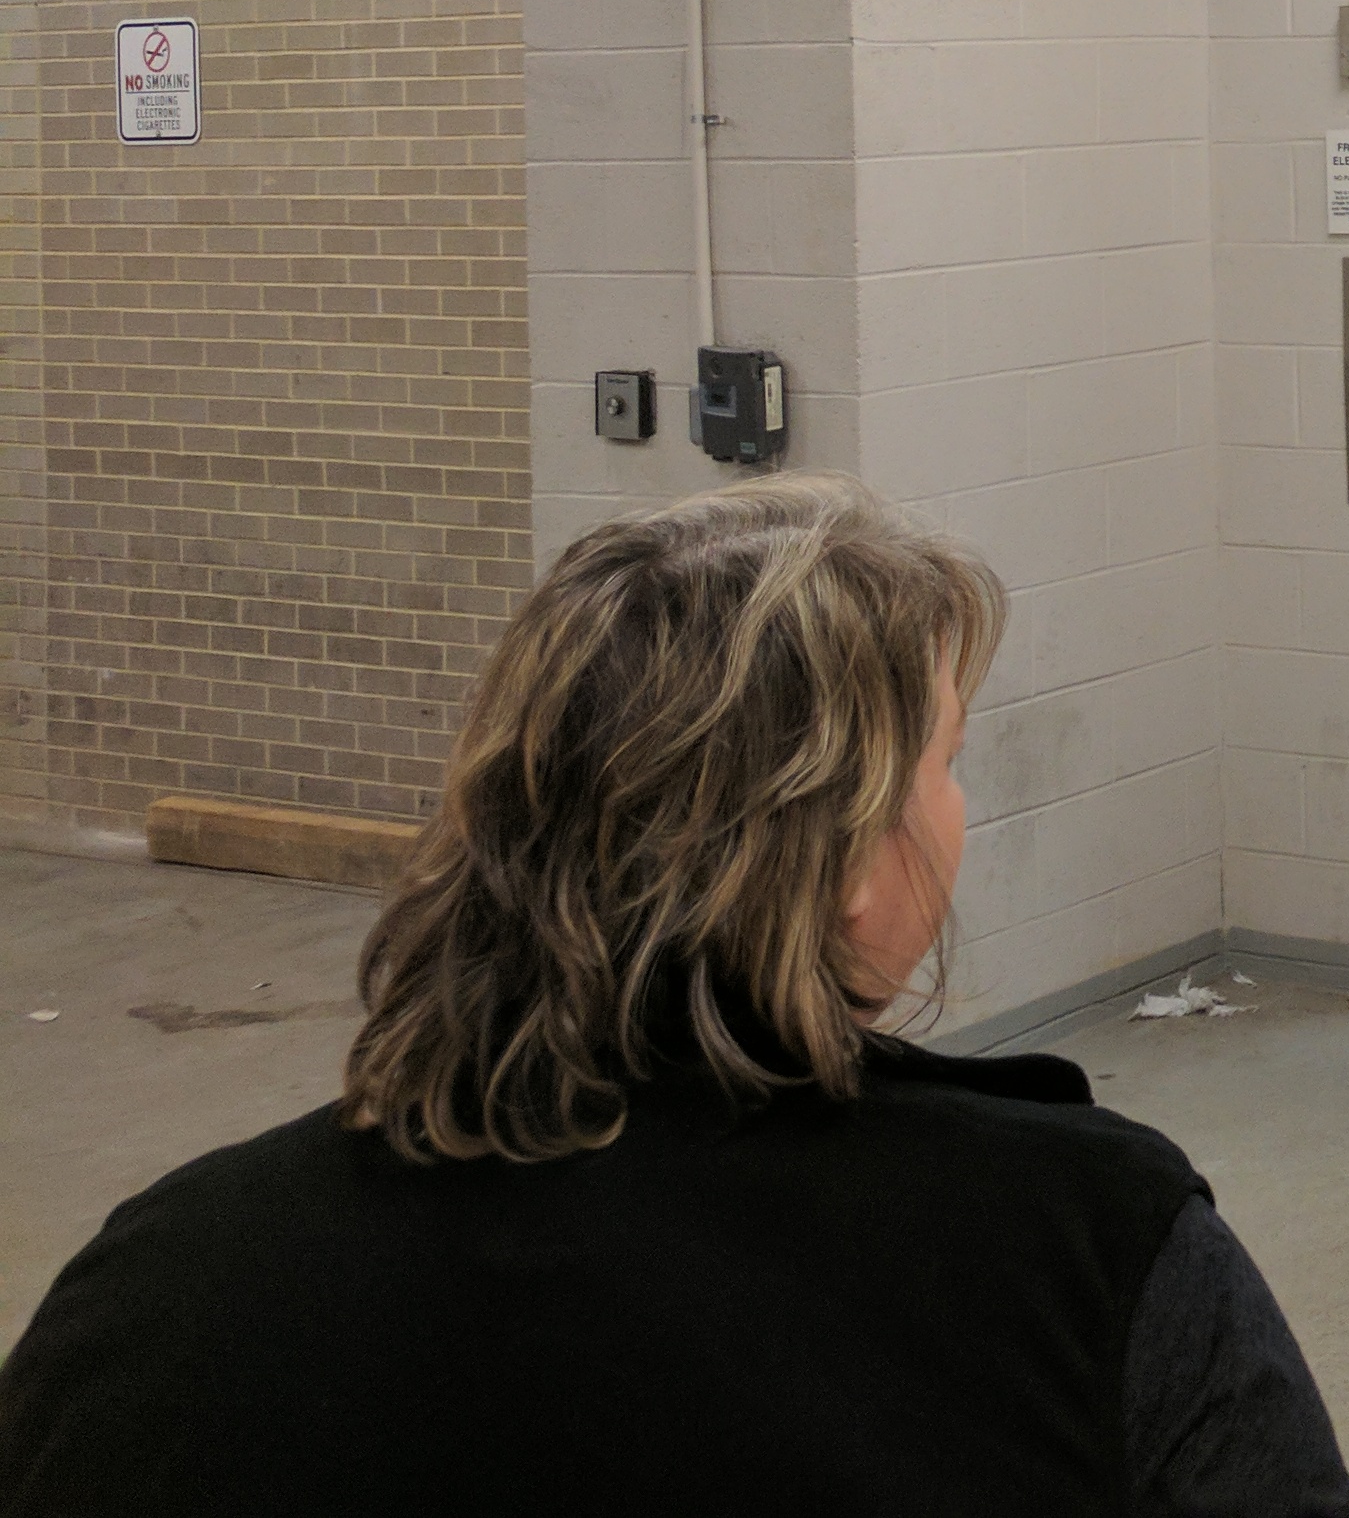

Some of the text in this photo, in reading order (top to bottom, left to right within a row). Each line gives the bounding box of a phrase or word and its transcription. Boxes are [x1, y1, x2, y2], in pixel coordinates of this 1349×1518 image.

[125, 73, 190, 91] NO SMOKING
[137, 95, 178, 107] INCLUDING
[135, 107, 181, 119] ELECTRONIC
[136, 119, 181, 131] CIGARETTES
